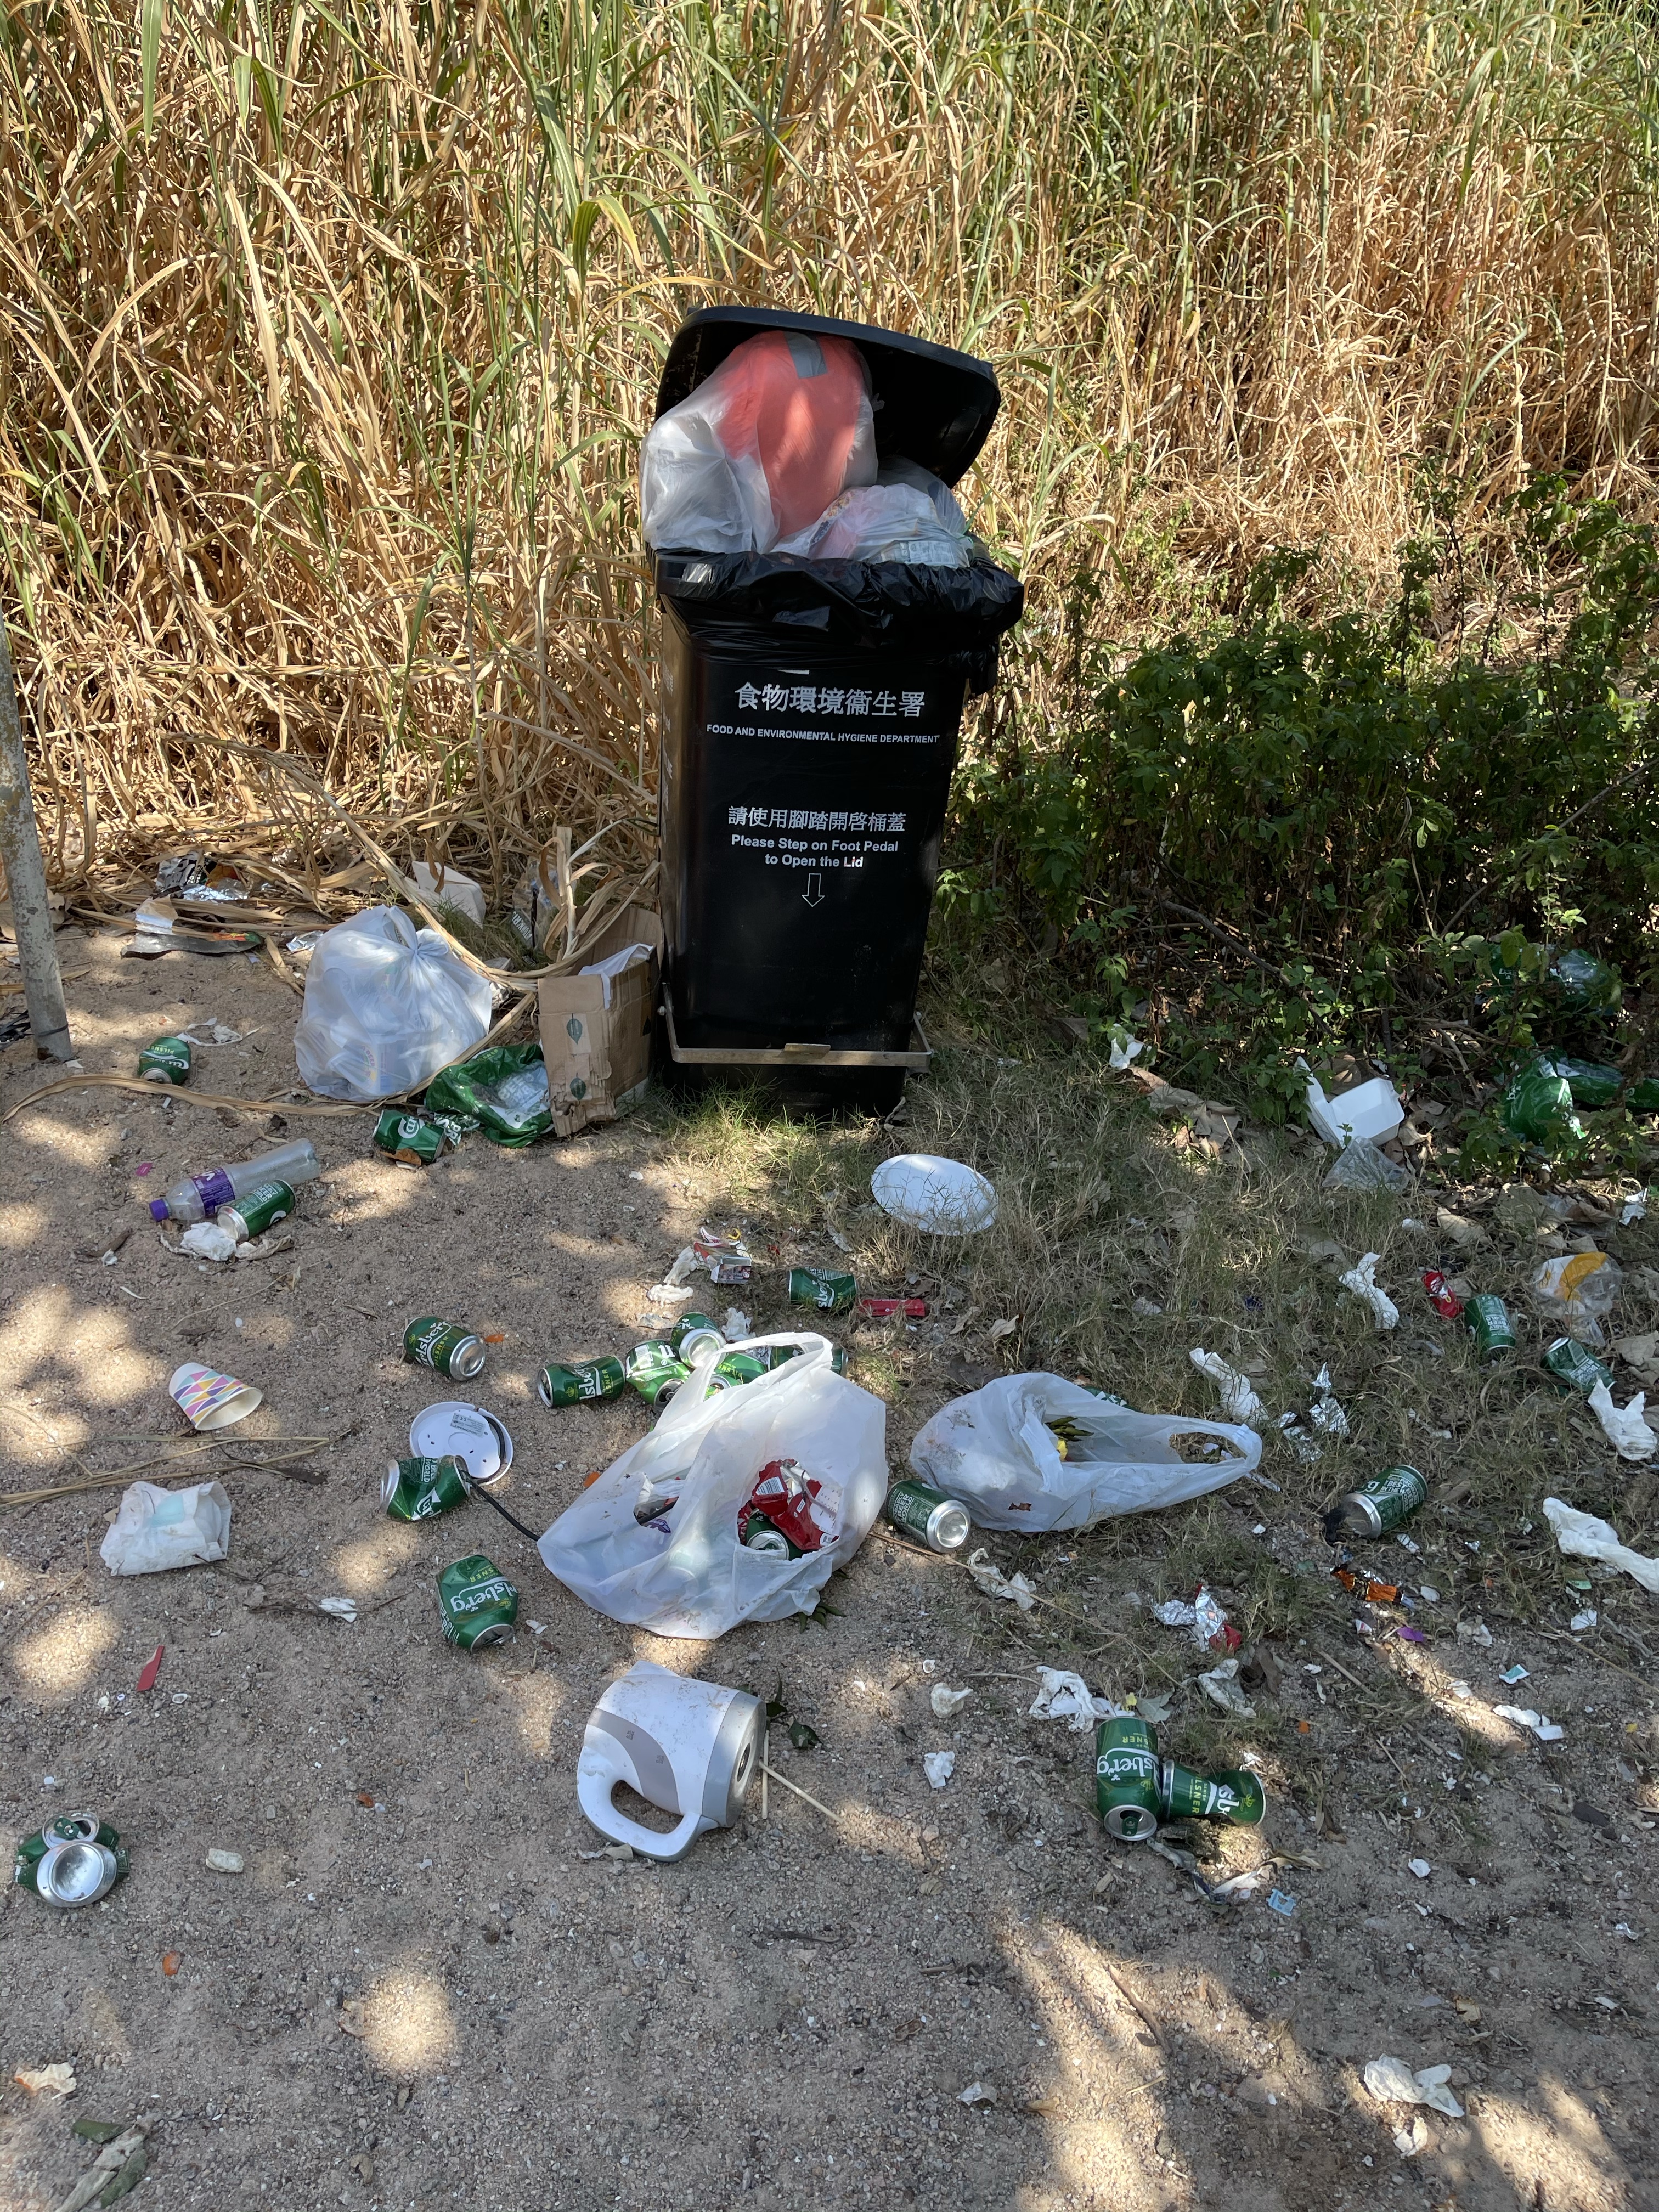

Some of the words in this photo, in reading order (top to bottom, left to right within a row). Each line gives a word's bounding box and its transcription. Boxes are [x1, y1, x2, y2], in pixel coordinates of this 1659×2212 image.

[707, 724, 733, 735] FOOD
[735, 726, 755, 736] AND
[758, 729, 836, 741] ENVIRONMENTAL
[838, 733, 877, 742] HYGIENE
[880, 734, 940, 743] DEPARTMENT
[731, 834, 775, 848] Please
[778, 838, 808, 852] Step
[811, 841, 827, 850] on
[832, 840, 860, 851] Foot
[864, 841, 898, 851] Pedal
[765, 854, 778, 865] to
[782, 854, 816, 868] Open
[820, 856, 839, 867] the
[843, 856, 864, 867] Lid
[435, 1336, 450, 1367] PILSNER
[423, 1458, 432, 1483] WORLD
[1387, 1480, 1408, 1488] BEST
[897, 1494, 909, 1517] BEER
